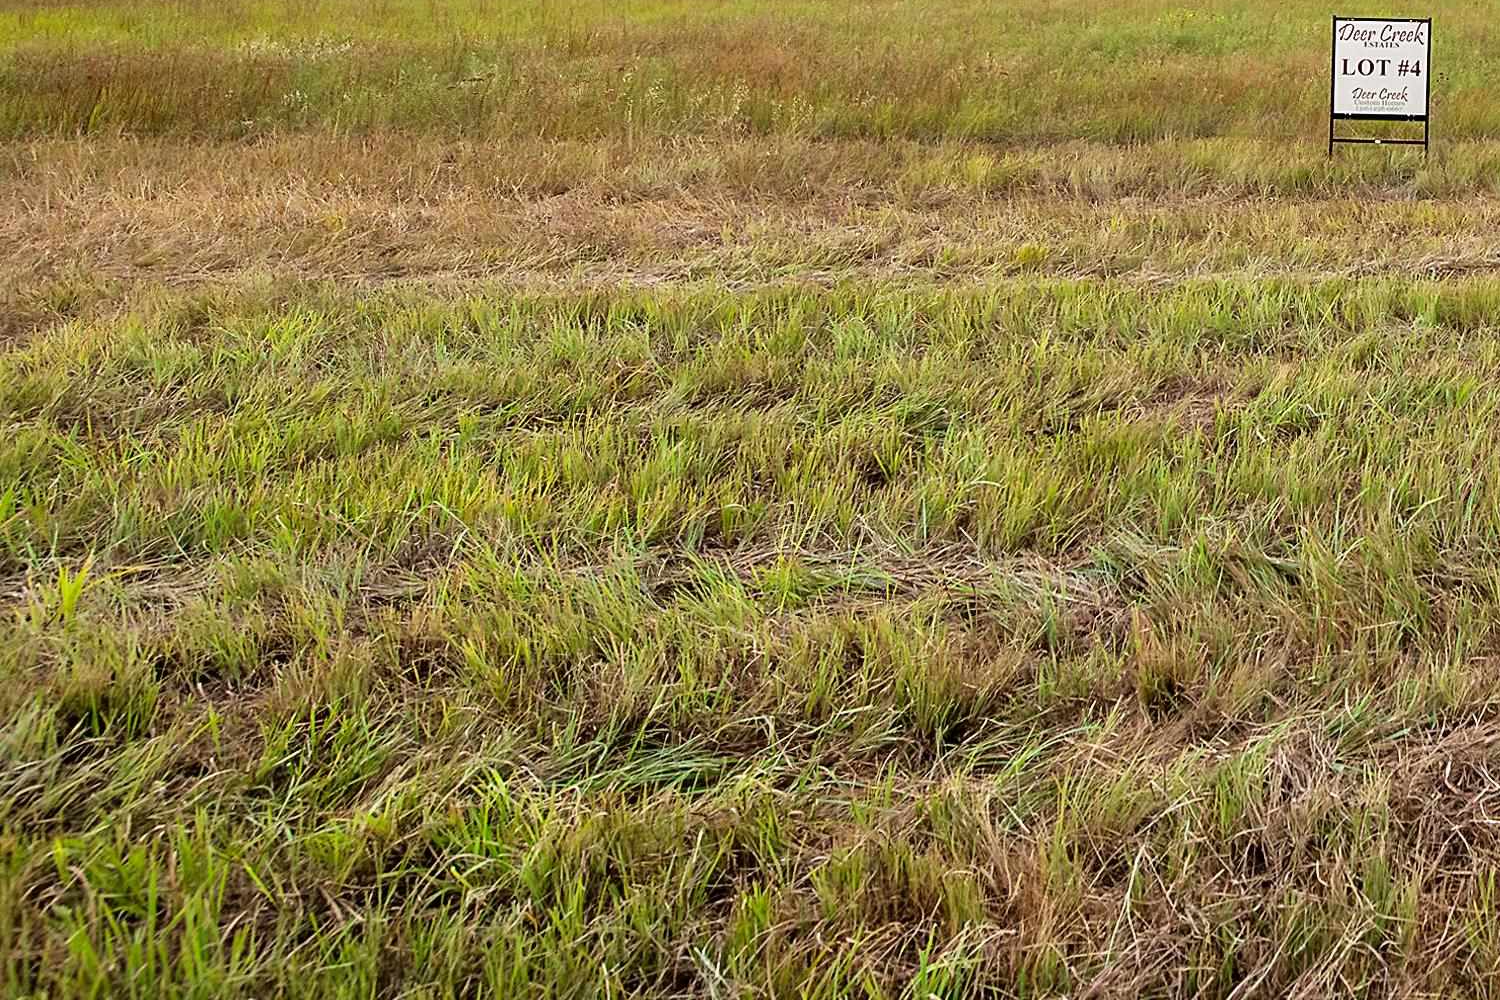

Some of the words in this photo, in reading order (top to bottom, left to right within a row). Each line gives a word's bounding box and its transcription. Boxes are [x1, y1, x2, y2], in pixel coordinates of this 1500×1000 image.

[1338, 23, 1376, 41] Deer
[1380, 21, 1424, 45] Creek
[1342, 58, 1391, 76] LOT
[1398, 60, 1421, 77] #4
[1351, 87, 1377, 100] Deer
[1379, 86, 1408, 102] Creek
